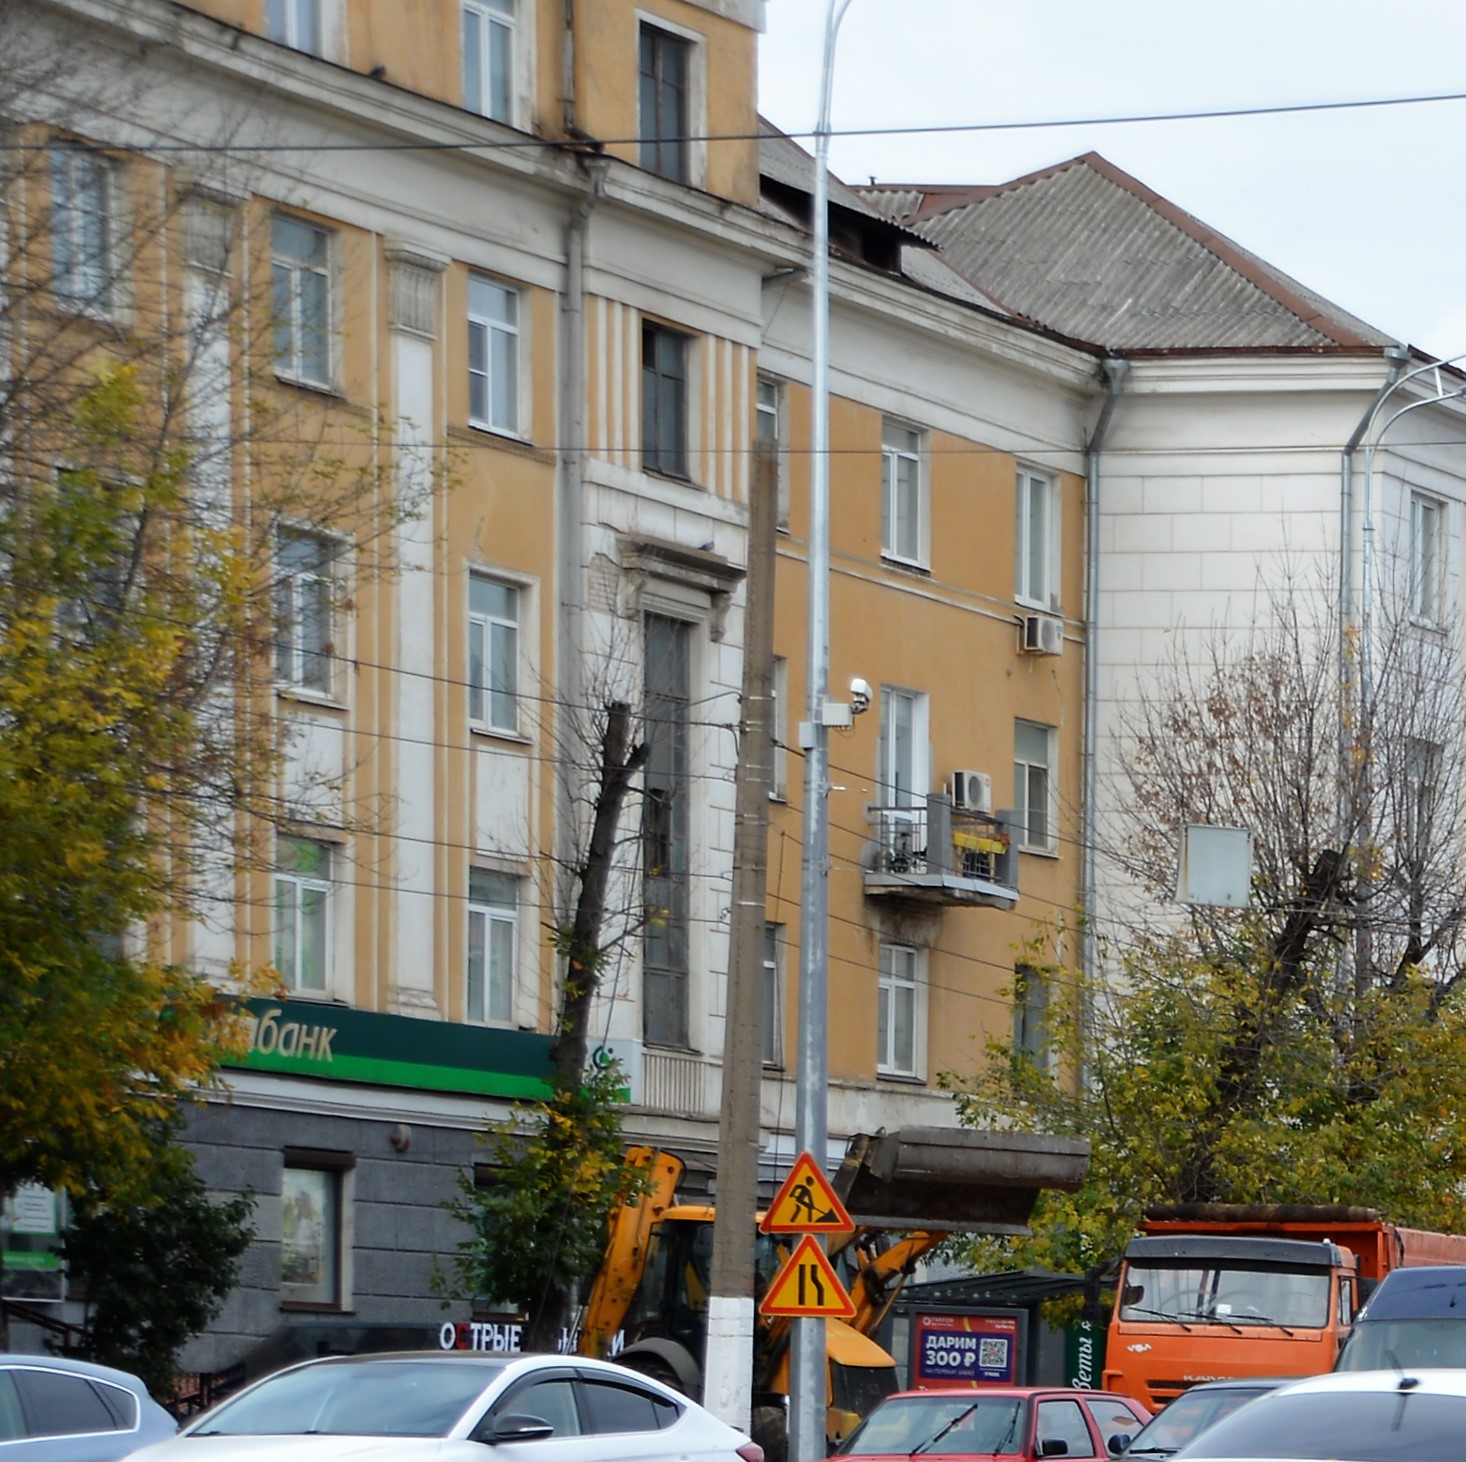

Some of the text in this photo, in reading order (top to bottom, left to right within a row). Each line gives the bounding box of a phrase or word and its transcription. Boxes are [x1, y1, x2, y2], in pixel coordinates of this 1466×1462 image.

[440, 1322, 522, 1352] ОСТРЫЕ
[926, 1335, 977, 1350] ДАРИМ
[926, 1351, 961, 1367] 300
